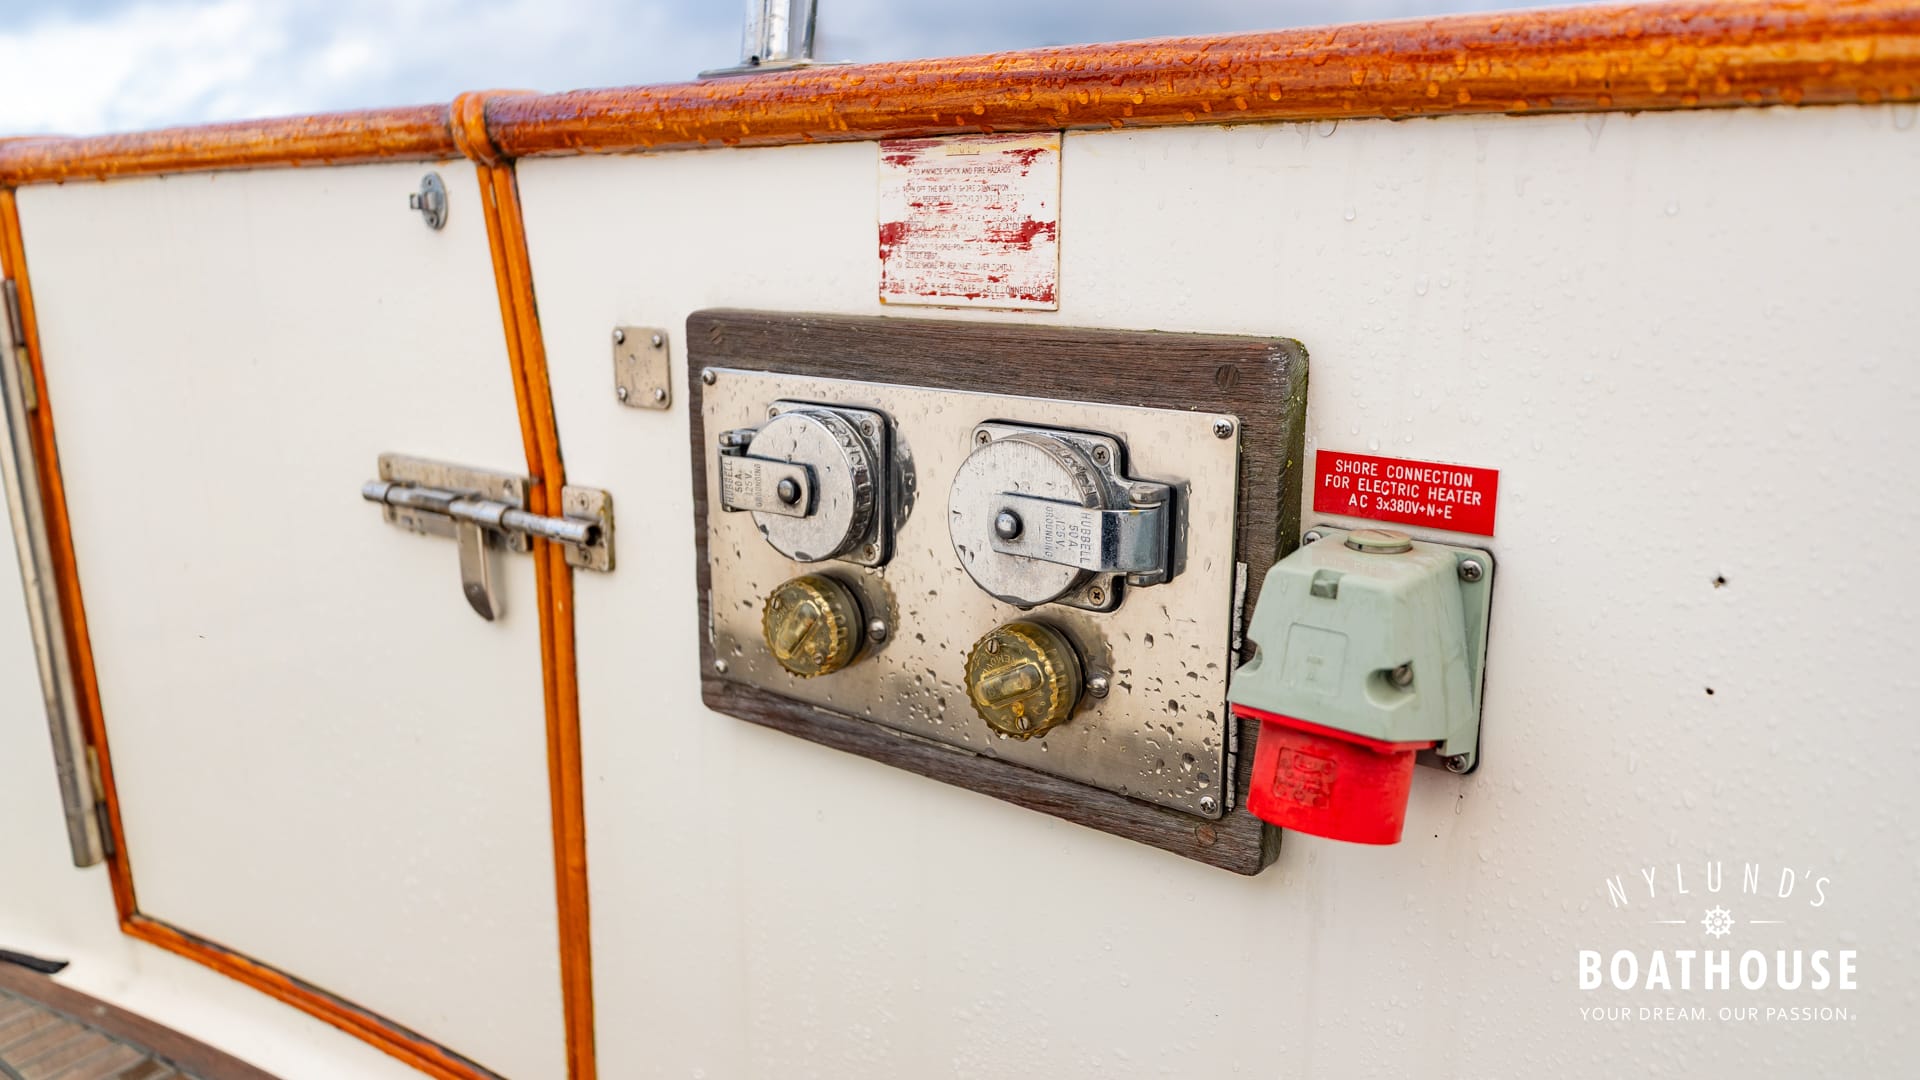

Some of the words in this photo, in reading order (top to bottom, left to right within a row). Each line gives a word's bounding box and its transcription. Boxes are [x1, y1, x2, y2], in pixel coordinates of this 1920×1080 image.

[1335, 459, 1379, 477] SHORE
[1386, 465, 1473, 488] CONNECTION
[1325, 474, 1350, 489] FOR
[1357, 477, 1420, 498] ELECTRIC
[1428, 486, 1482, 506] HEATER
[1349, 493, 1368, 508] AC
[1376, 498, 1453, 519] 3x380V+N+E
[1080, 511, 1092, 563] HUBBELL
